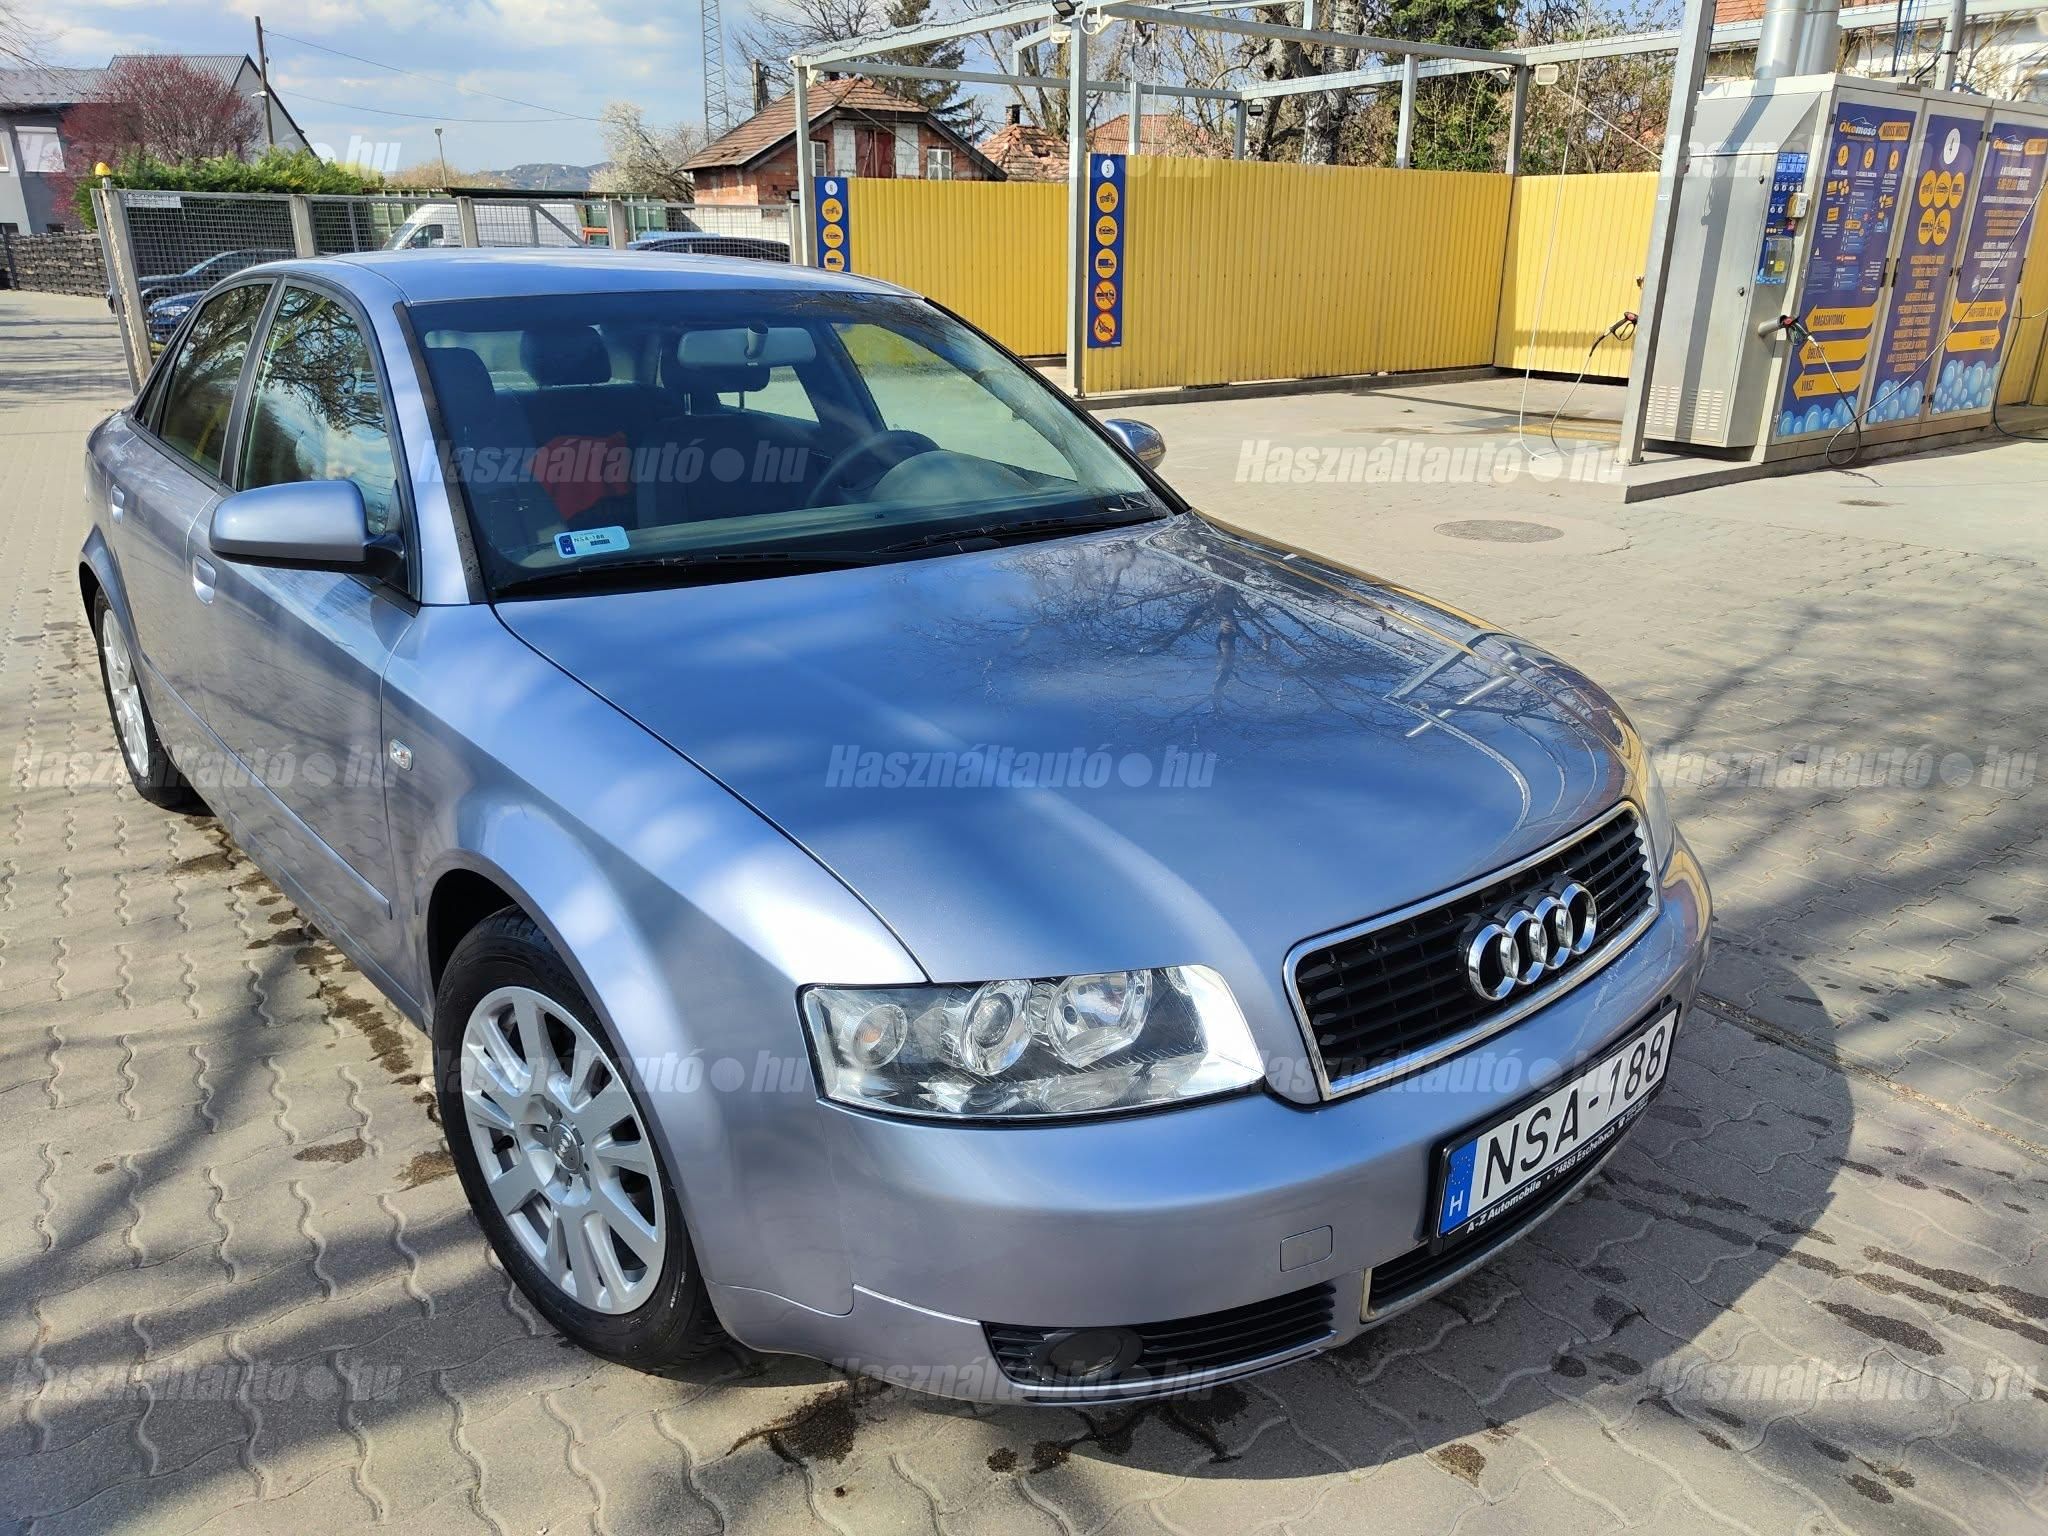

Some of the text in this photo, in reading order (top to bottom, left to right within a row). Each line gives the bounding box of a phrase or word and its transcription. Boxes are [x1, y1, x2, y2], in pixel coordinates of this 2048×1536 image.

[1480, 1025, 1667, 1201] NSA-188
[1448, 1190, 1465, 1217] H
[1466, 1211, 1490, 1235] A-Z
[1488, 1179, 1542, 1222] Automobile
